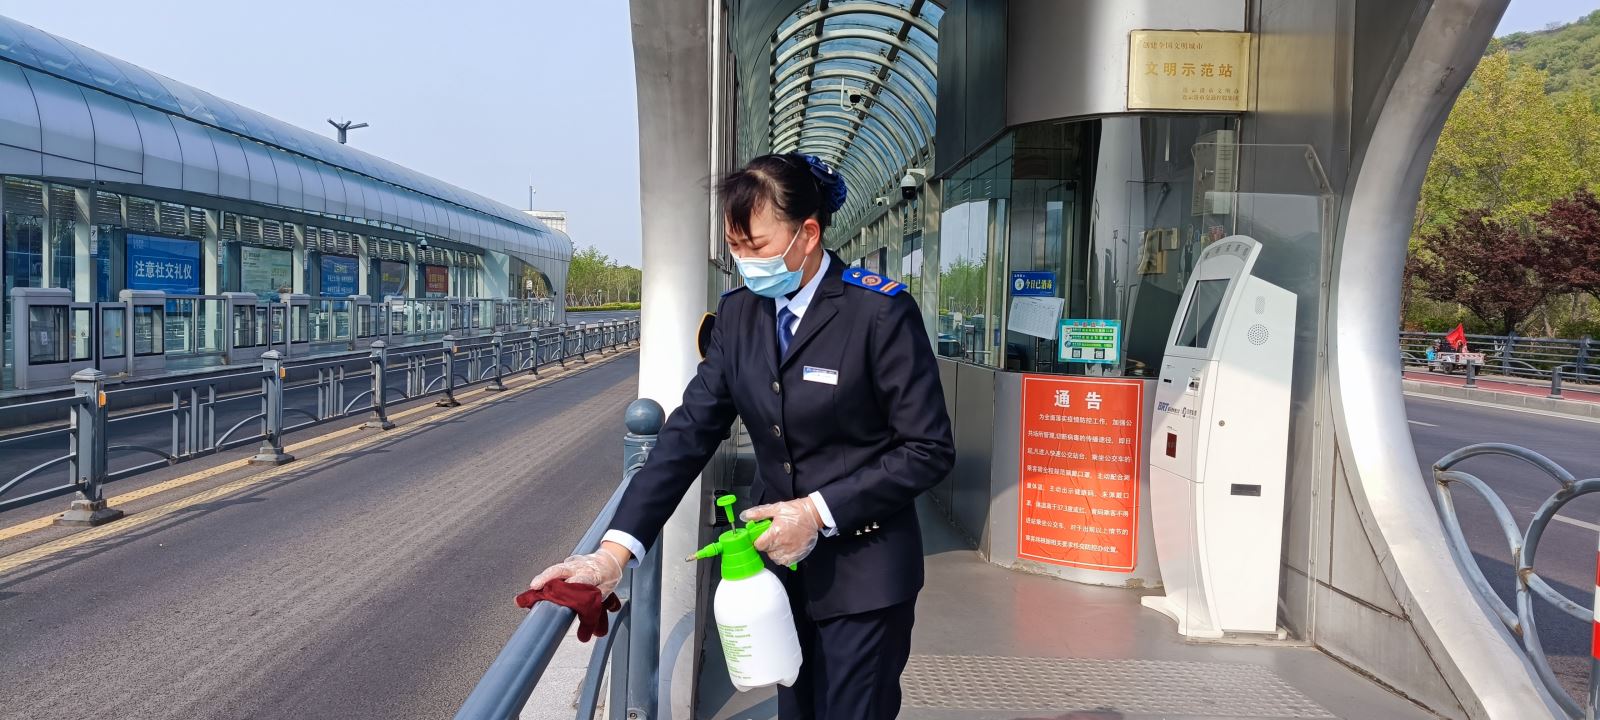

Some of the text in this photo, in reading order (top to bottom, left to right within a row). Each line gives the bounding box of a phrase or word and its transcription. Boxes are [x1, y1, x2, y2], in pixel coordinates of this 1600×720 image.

[1145, 62, 1233, 78] 文明示范站
[135, 260, 192, 280] 注意社交礼仪
[1025, 278, 1052, 290] 今日已消毒
[1054, 389, 1103, 410] 通告
[1157, 401, 1169, 412] BRT
